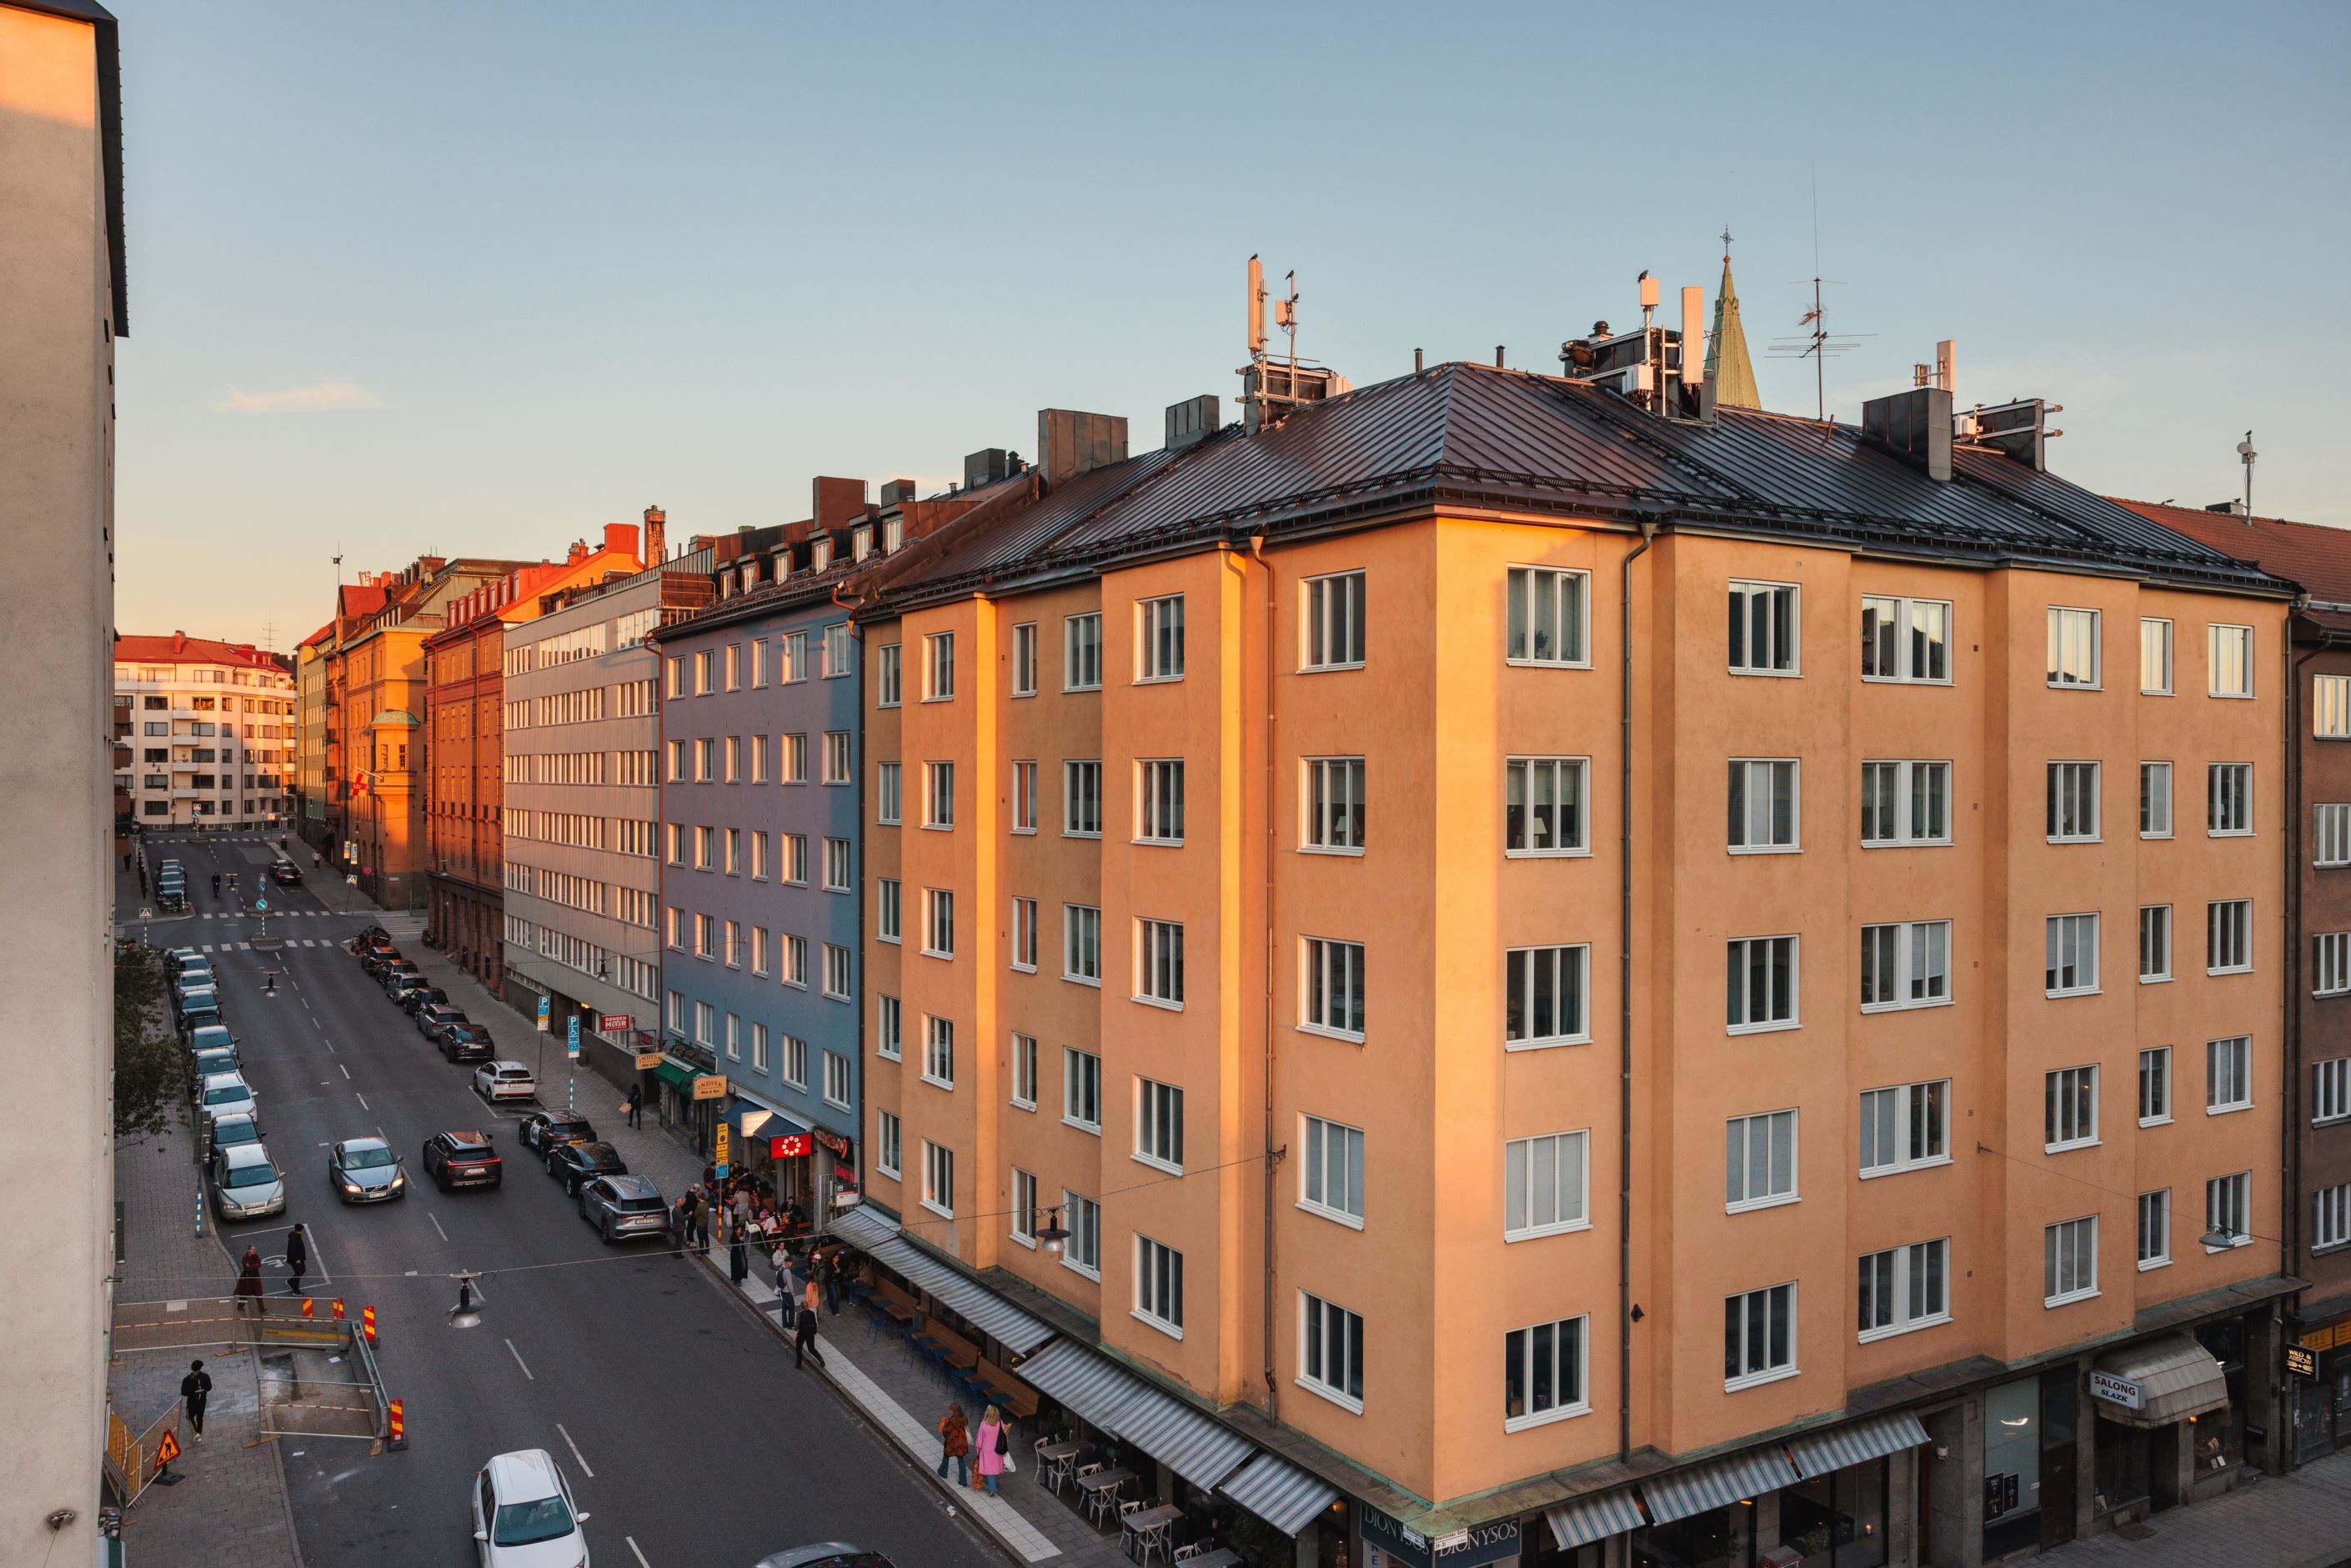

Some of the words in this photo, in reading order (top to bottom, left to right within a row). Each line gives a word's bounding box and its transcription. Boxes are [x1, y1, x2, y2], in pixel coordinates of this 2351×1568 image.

[698, 1080, 722, 1091] INDISK
[2288, 1349, 2304, 1358] WILD
[2288, 1355, 2312, 1365] ARROW
[2094, 1375, 2136, 1396] SALONG
